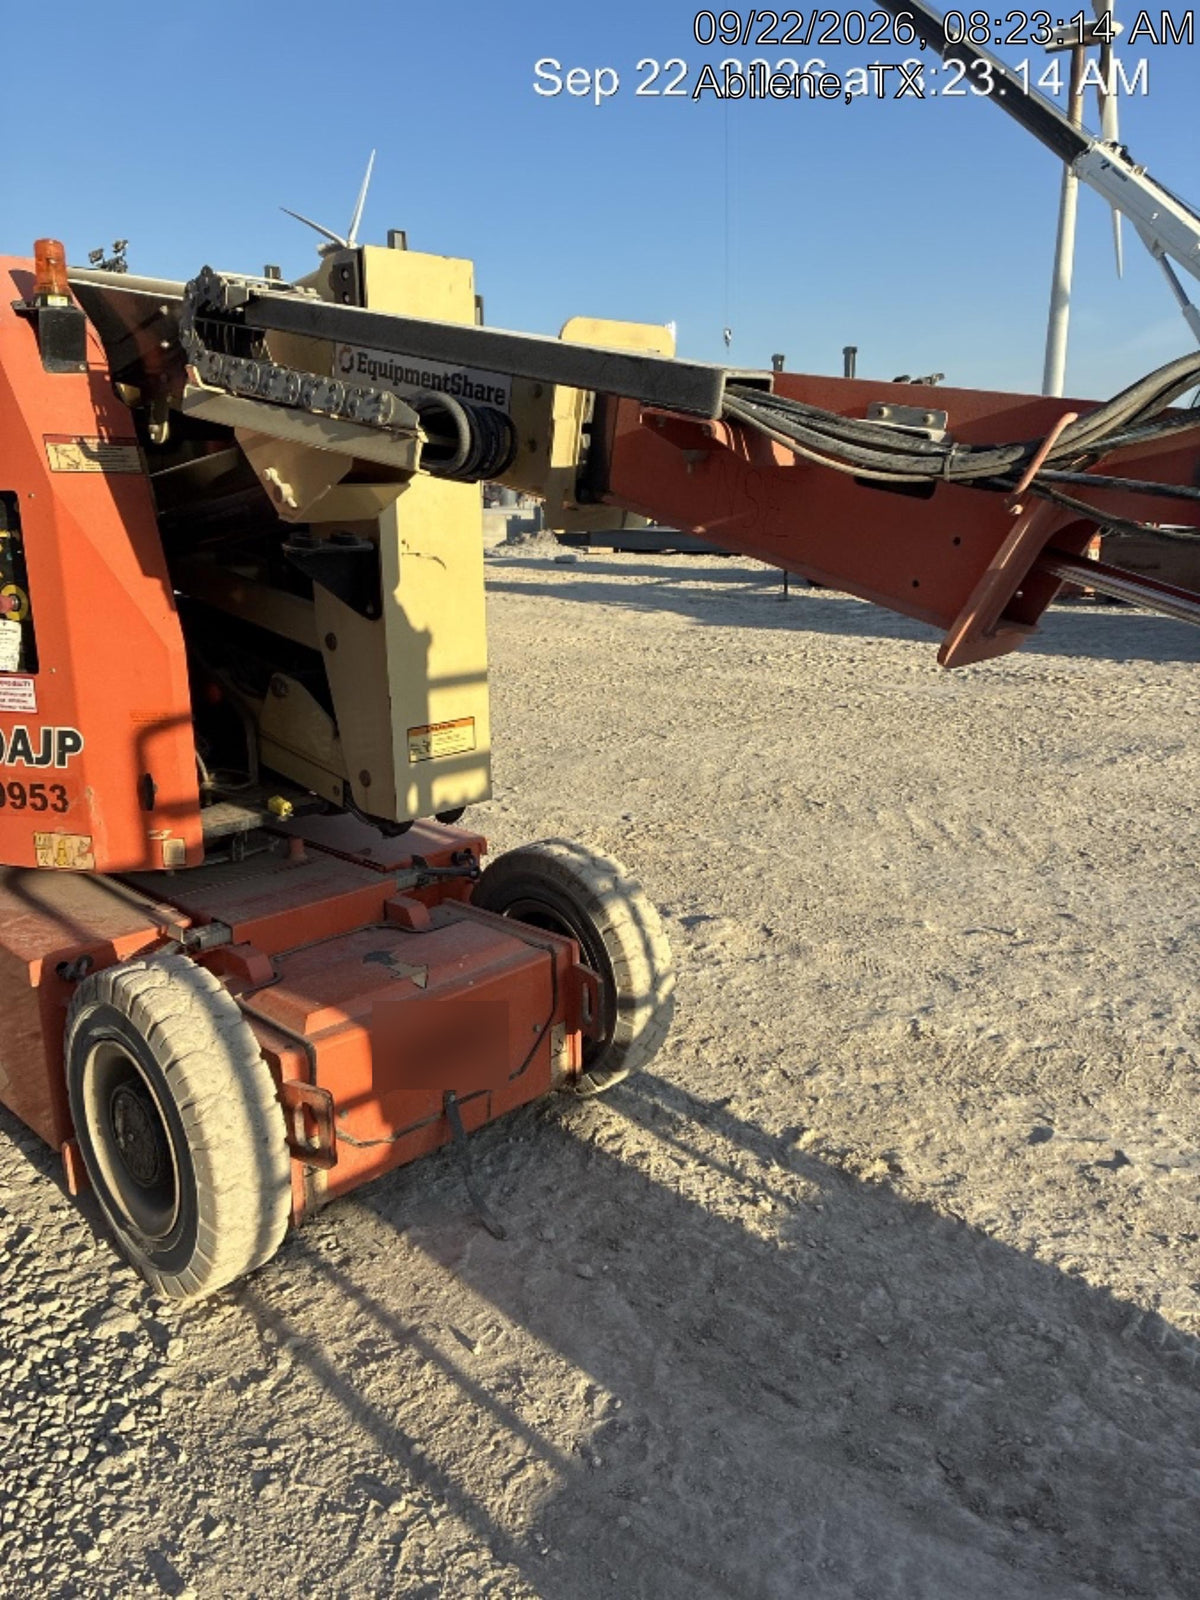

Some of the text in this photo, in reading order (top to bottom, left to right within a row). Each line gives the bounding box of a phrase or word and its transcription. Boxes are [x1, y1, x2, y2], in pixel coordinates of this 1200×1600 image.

[356, 351, 507, 406] EquipmentShare
[0, 725, 84, 768] AJP
[0, 782, 70, 814] 953
